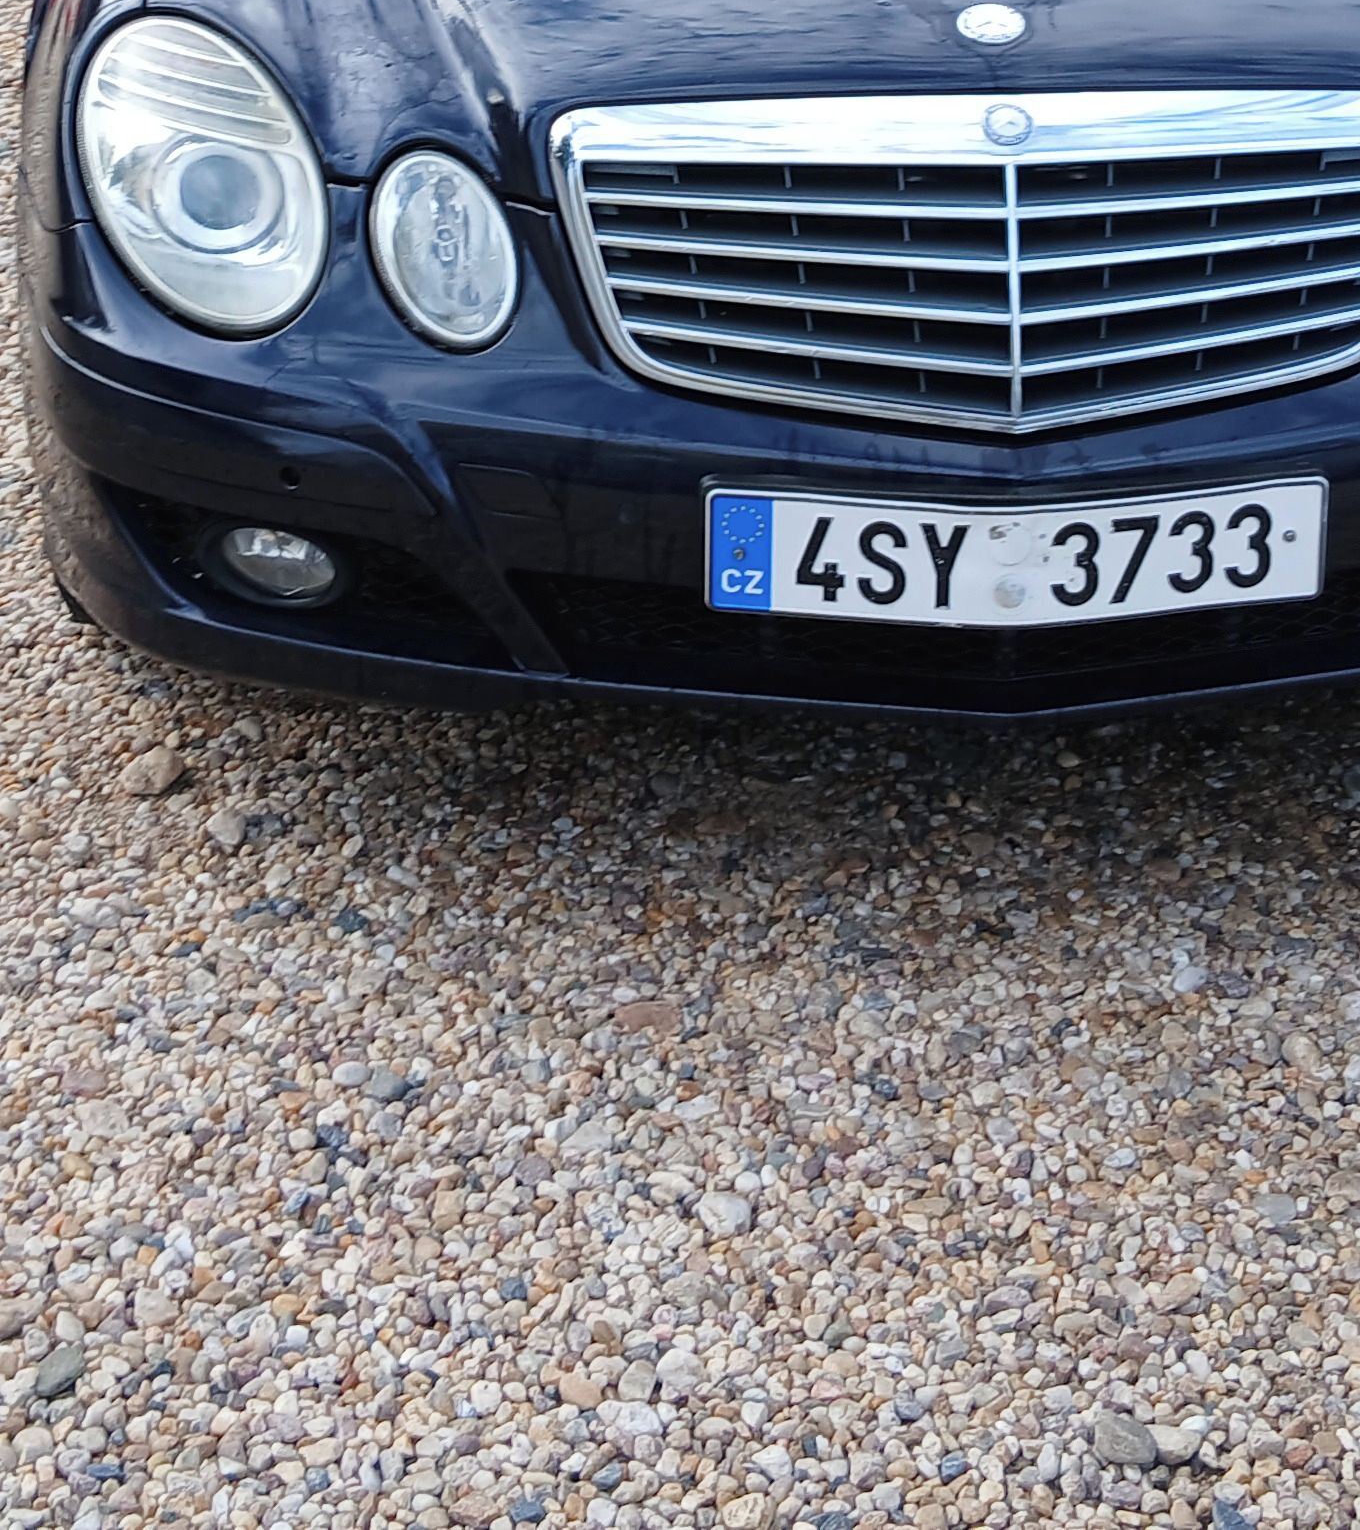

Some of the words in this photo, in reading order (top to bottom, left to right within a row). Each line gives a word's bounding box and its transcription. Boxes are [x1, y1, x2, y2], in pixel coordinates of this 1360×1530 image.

[721, 568, 764, 594] CZ
[795, 516, 971, 609] 4SY
[1050, 503, 1272, 607] 3733
